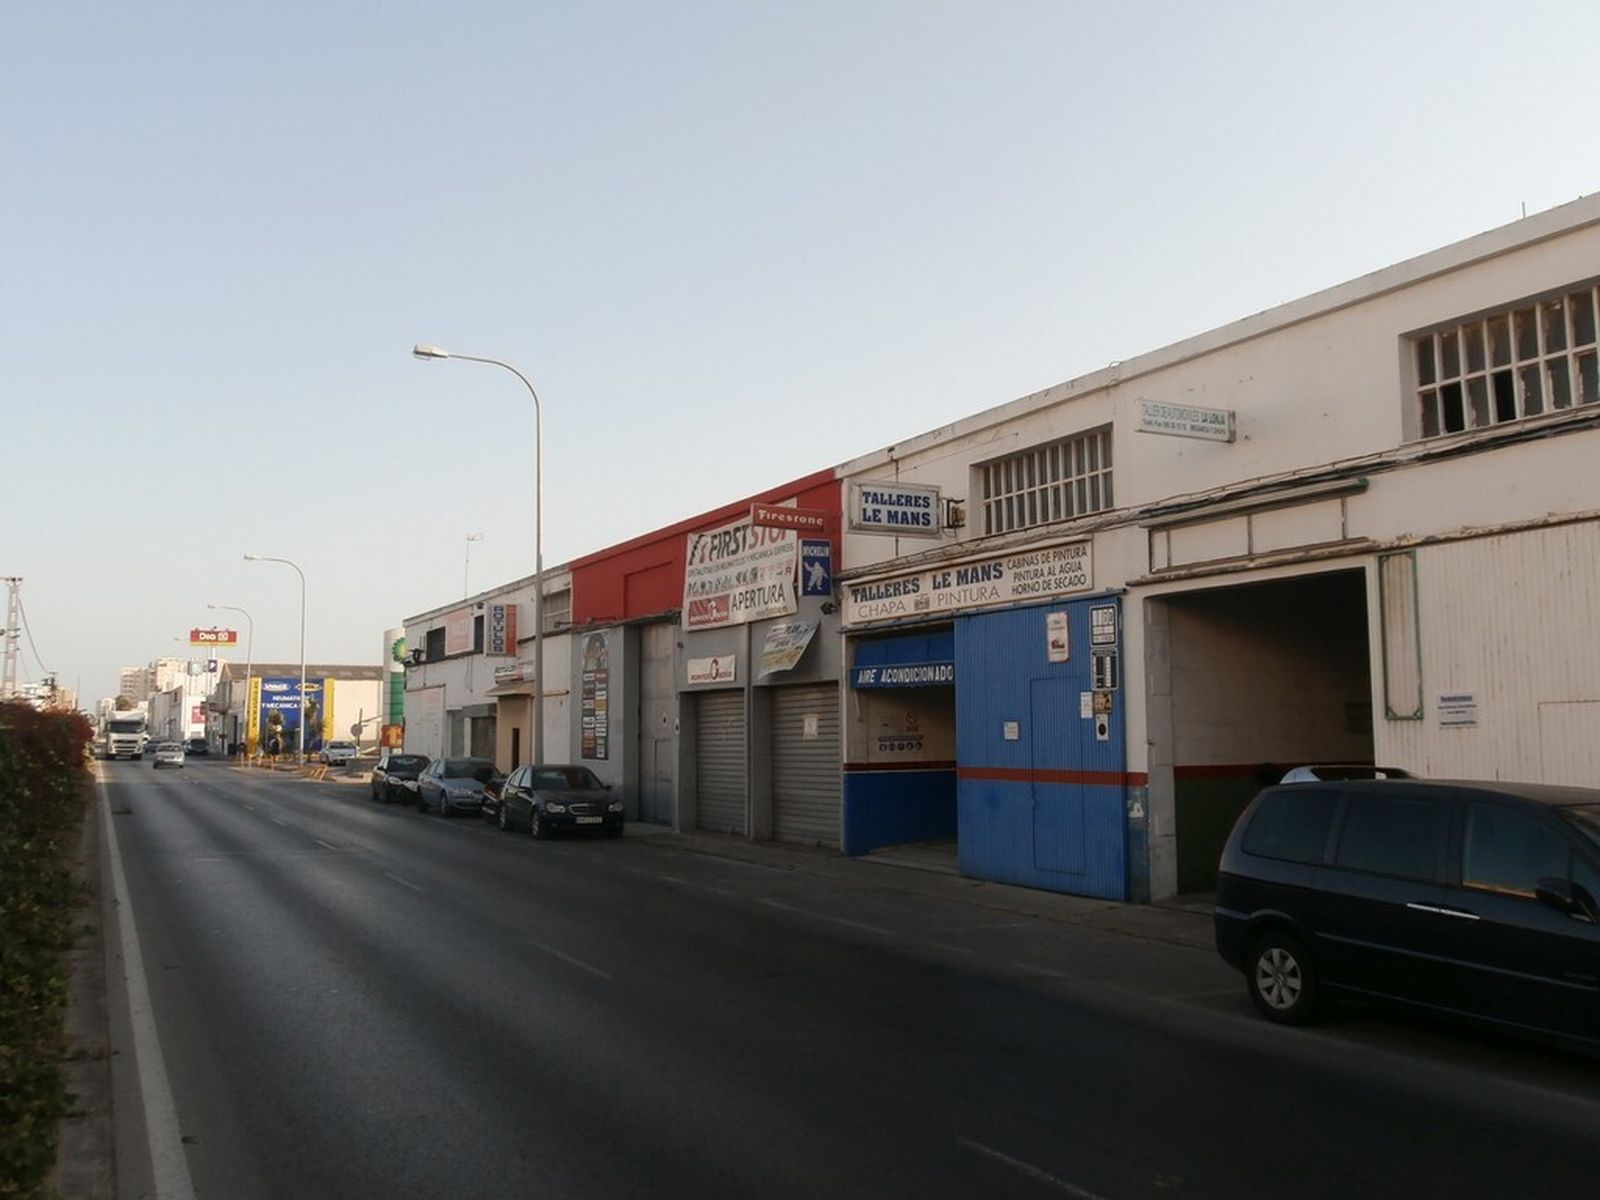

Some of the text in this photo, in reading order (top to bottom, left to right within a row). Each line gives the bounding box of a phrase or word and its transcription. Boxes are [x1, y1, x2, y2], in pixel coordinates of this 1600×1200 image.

[862, 491, 931, 509] TALLERES
[757, 509, 824, 526] Firestone
[862, 508, 931, 526] LE MANS
[803, 545, 829, 557] MICHELIN
[1007, 546, 1088, 570] CABINAS DE PINTURA
[851, 562, 1004, 603] TALLERES LE MANS
[1013, 561, 1083, 583] PINTURA AL AGUA
[1012, 573, 1087, 595] HORNO DE SECADO
[731, 583, 786, 612] APERTURA
[857, 585, 1001, 618] CHAPA PINTURA
[493, 605, 504, 652] ROTULOS
[857, 664, 954, 684] AIRE ACONDICIONADO
